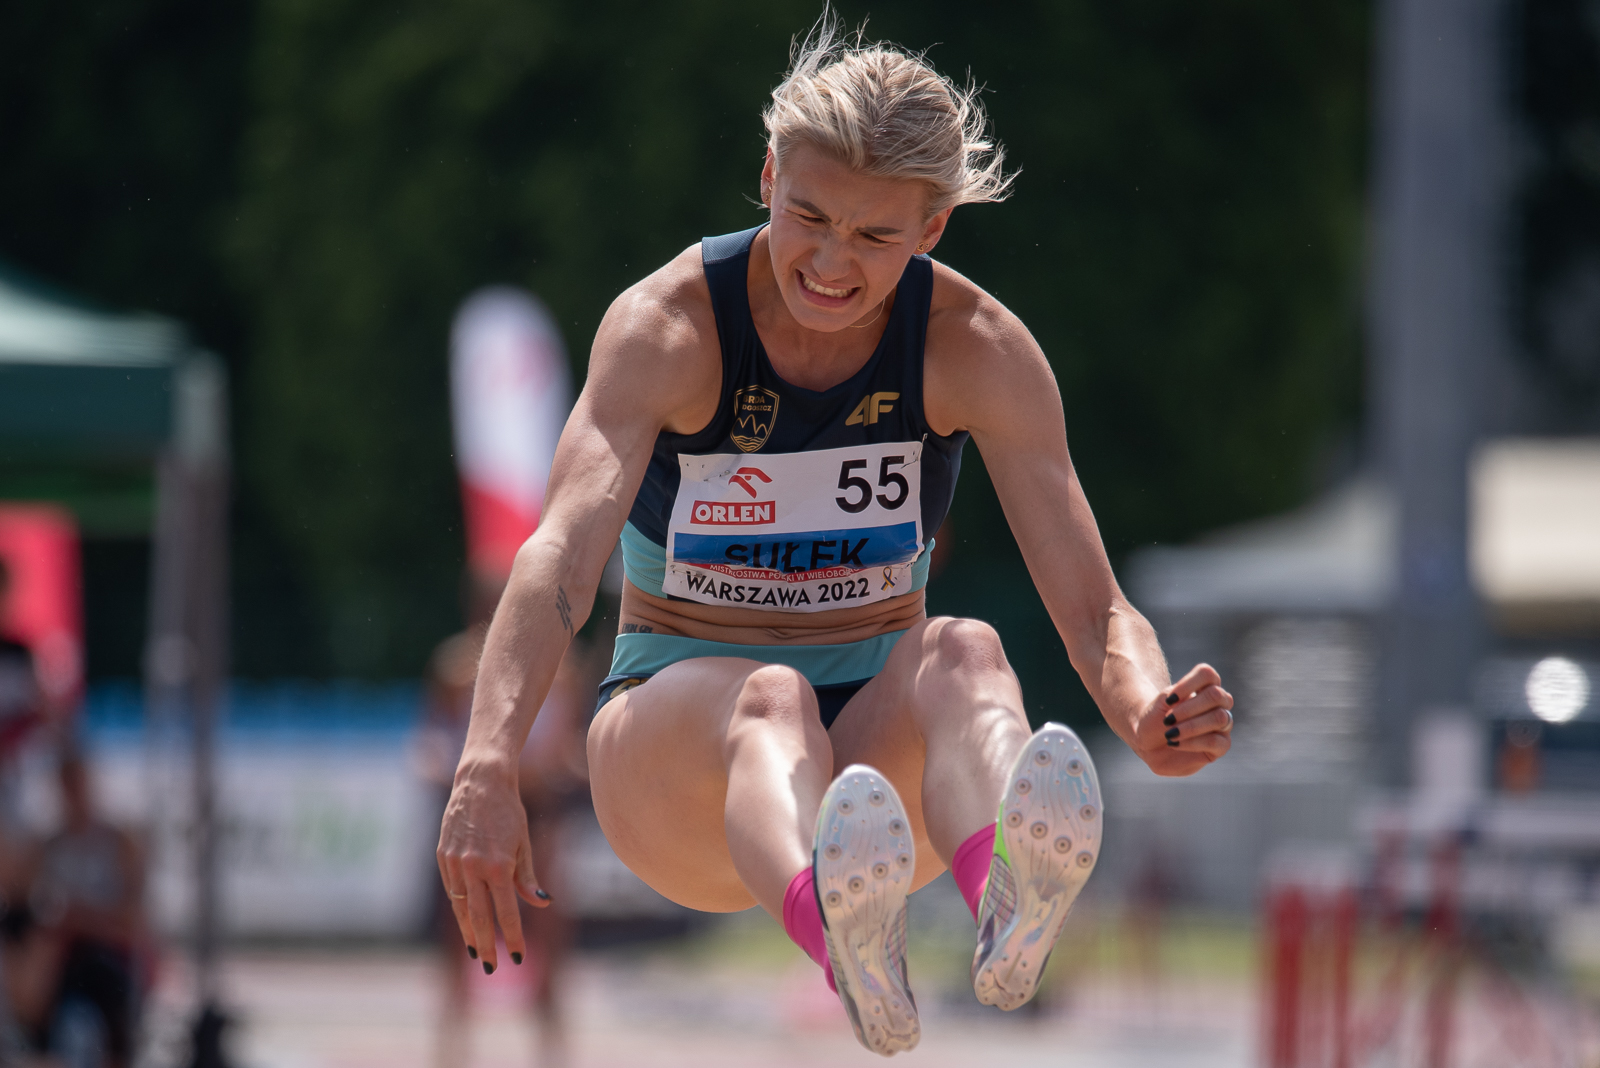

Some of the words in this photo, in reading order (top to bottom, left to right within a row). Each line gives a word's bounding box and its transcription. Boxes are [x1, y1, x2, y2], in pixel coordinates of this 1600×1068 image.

[845, 392, 900, 427] 4F
[835, 455, 909, 514] 55
[695, 504, 770, 522] ORLEN
[686, 571, 812, 608] WARSZAWA
[818, 577, 871, 603] 2022
[796, 573, 805, 581] W
